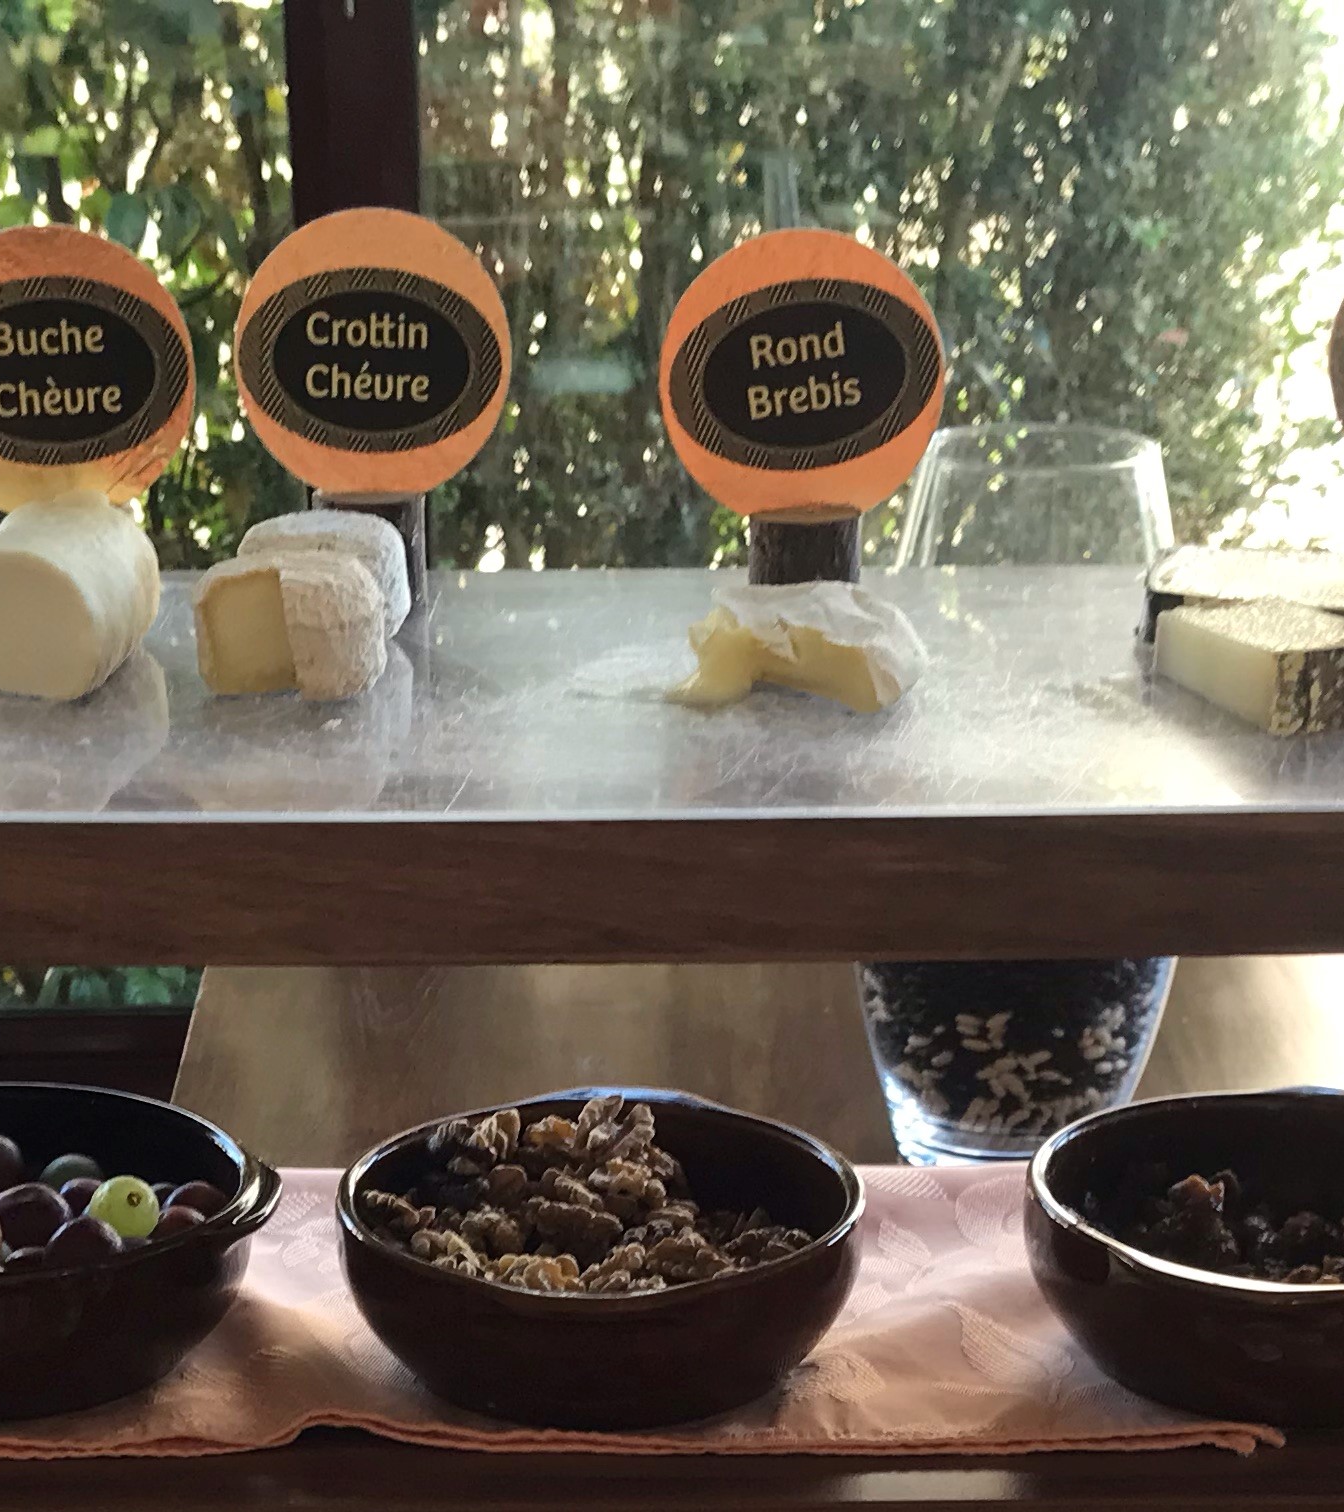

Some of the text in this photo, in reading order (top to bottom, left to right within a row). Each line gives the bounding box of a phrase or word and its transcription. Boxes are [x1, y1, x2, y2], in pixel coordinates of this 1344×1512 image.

[306, 311, 428, 349] Crottin
[749, 320, 845, 370] Rond
[747, 371, 862, 420] Brebis
